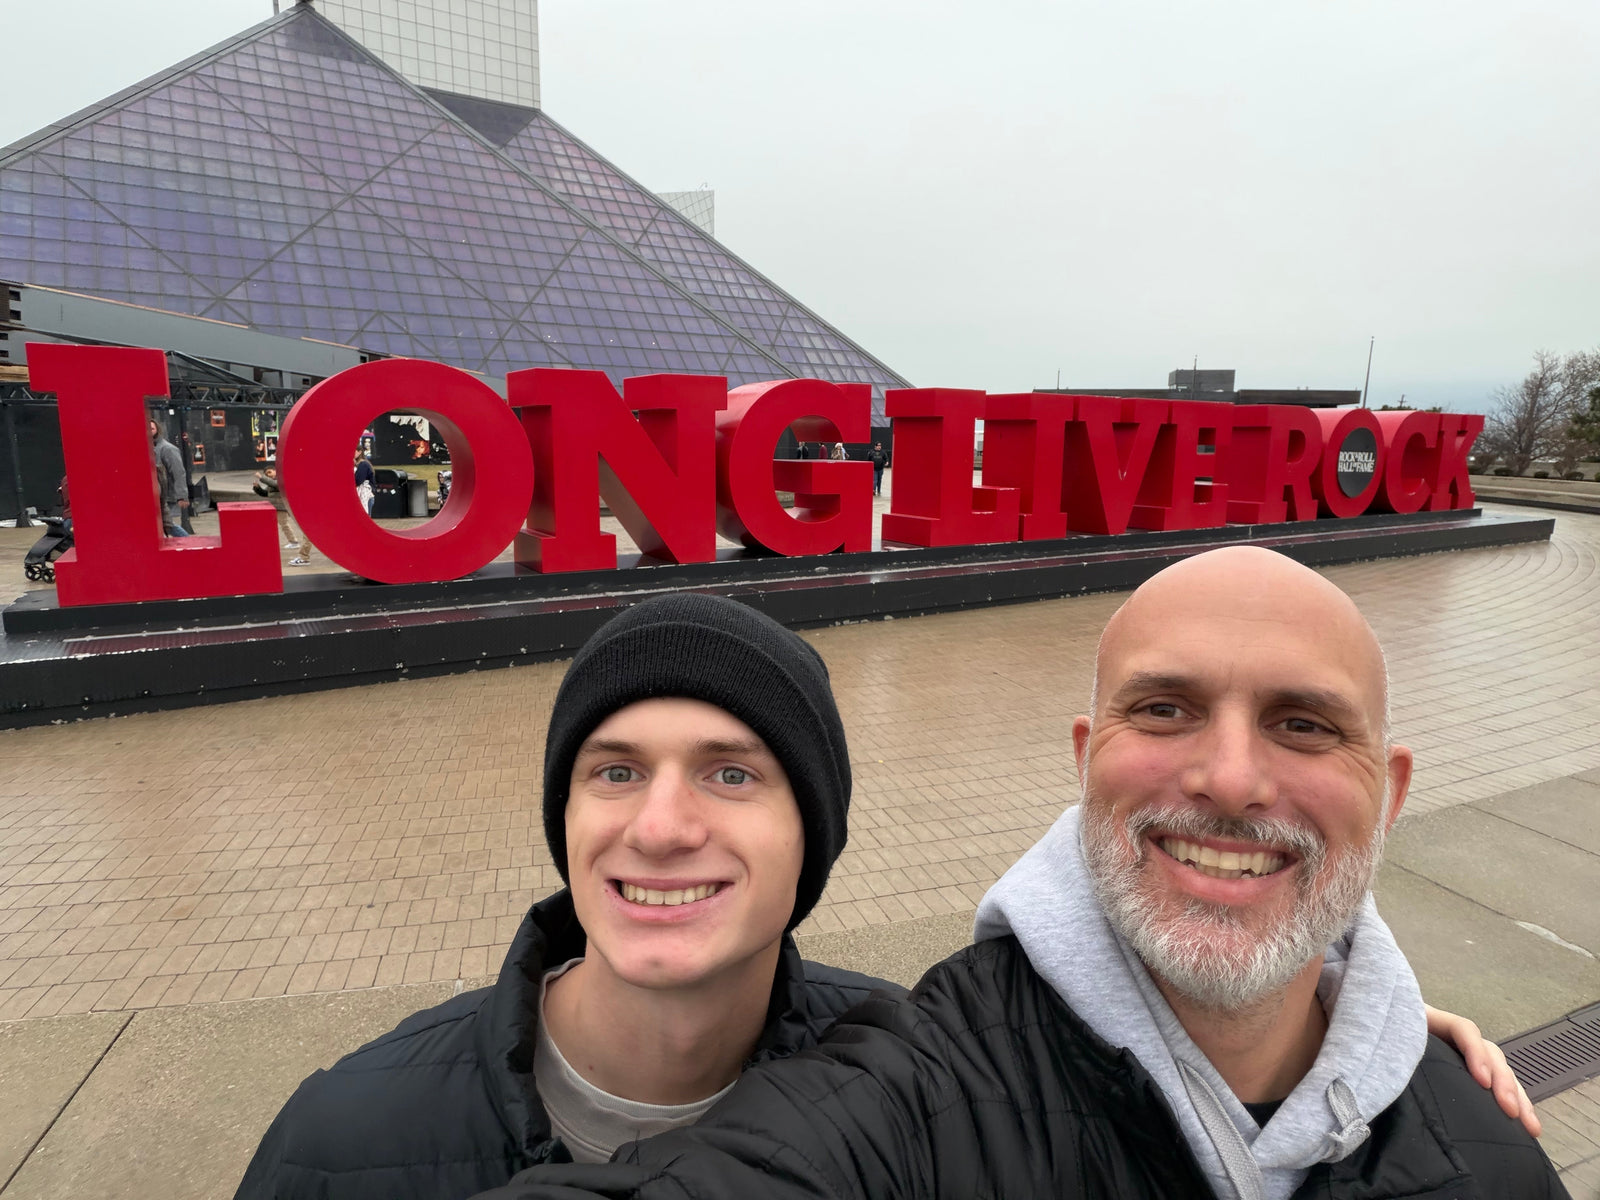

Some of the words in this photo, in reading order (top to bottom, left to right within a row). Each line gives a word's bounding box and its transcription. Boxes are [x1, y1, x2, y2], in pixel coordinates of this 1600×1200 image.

[1339, 451, 1355, 462] ROCK
[1357, 451, 1374, 462] ROLL
[1338, 462, 1354, 473] HALL
[1356, 462, 1374, 473] FAME
[27, 342, 873, 607] LONG
[882, 387, 1234, 547] LIVE
[1227, 404, 1485, 525] ROCK
